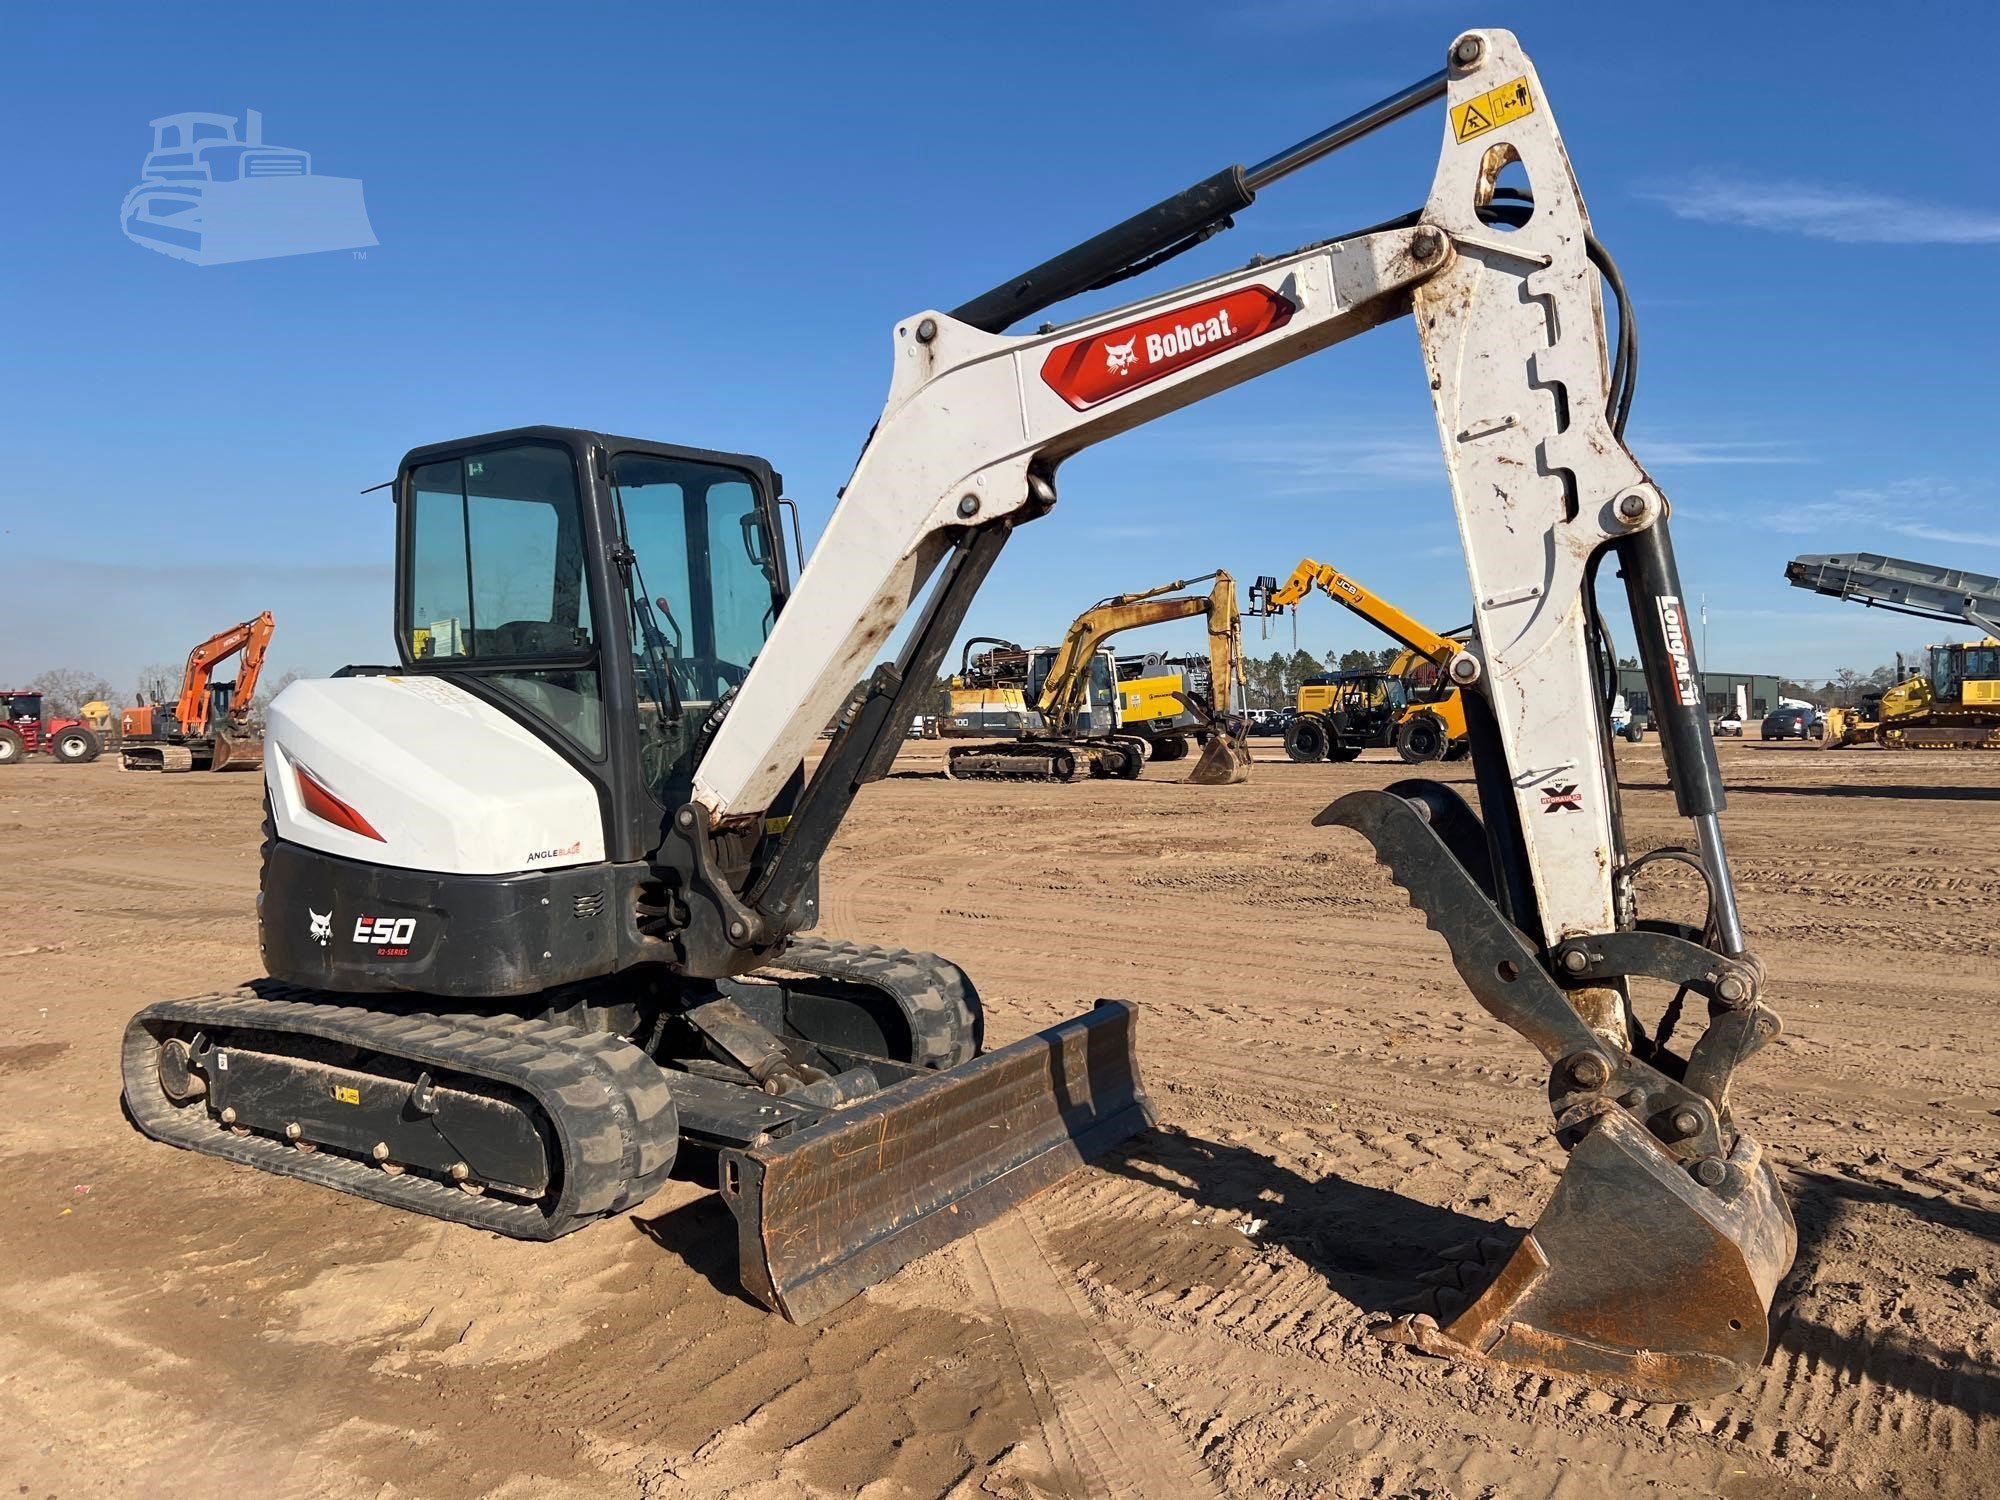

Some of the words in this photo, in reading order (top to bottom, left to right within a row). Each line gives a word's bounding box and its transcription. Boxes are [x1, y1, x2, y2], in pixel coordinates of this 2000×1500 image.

[1145, 308, 1232, 364] Bobcat
[1336, 579, 1357, 595] JCB
[1541, 794, 1581, 804] HYDRAULIC
[352, 916, 417, 945] E50
[377, 948, 409, 956] R2-SERIES
